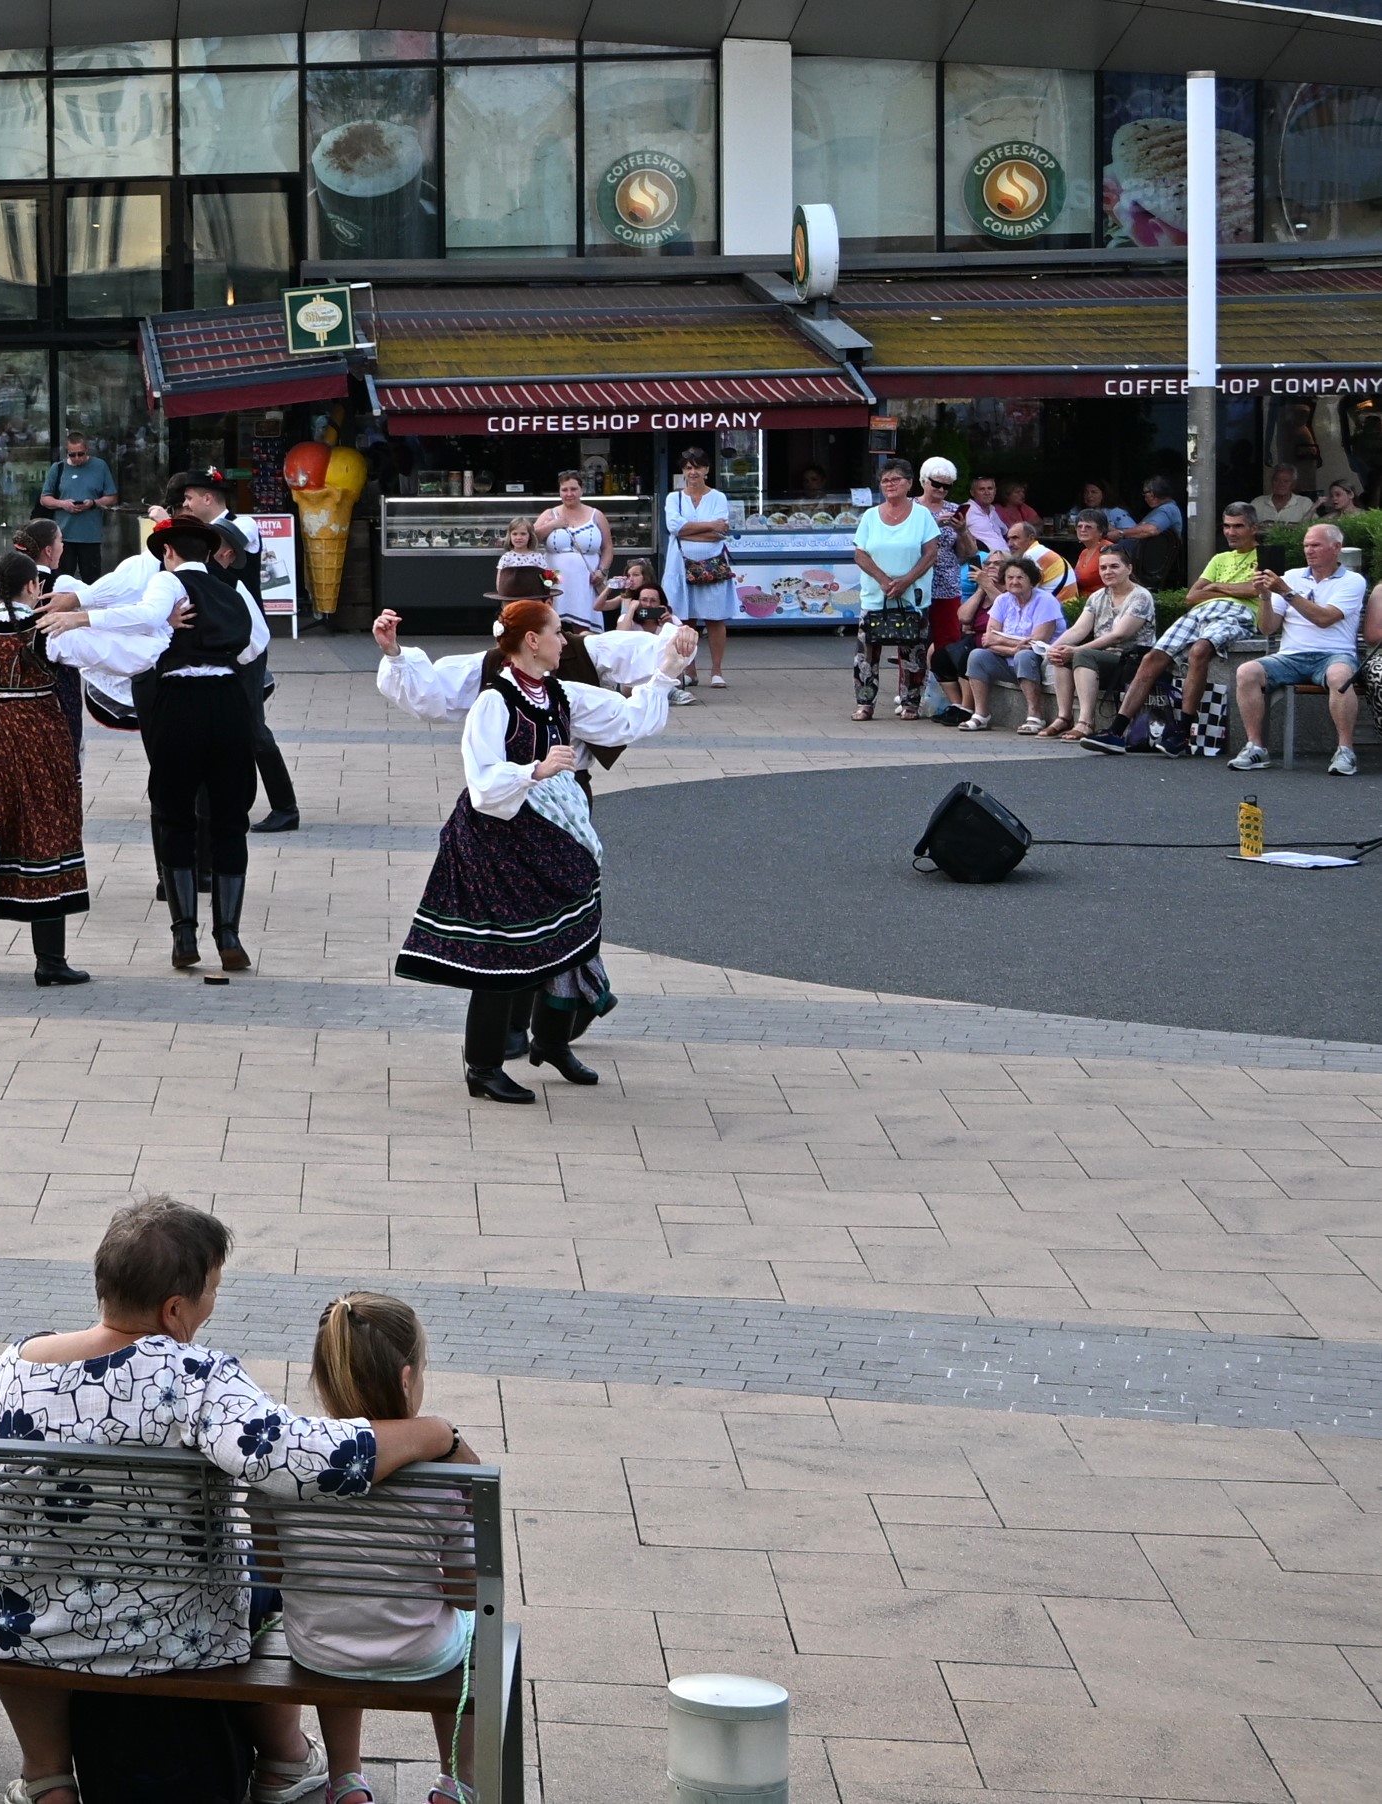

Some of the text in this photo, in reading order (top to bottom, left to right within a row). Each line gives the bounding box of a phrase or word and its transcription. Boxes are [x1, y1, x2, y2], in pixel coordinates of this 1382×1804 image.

[606, 154, 686, 183] COFFEESHOP
[974, 144, 1055, 175] COFFEESHOP
[615, 221, 680, 244] COMPANY
[983, 212, 1050, 236] COMPANY
[1105, 377, 1382, 396] COFFEEHOP COMPANY
[487, 411, 762, 432] COFFEESHOP COMPANY
